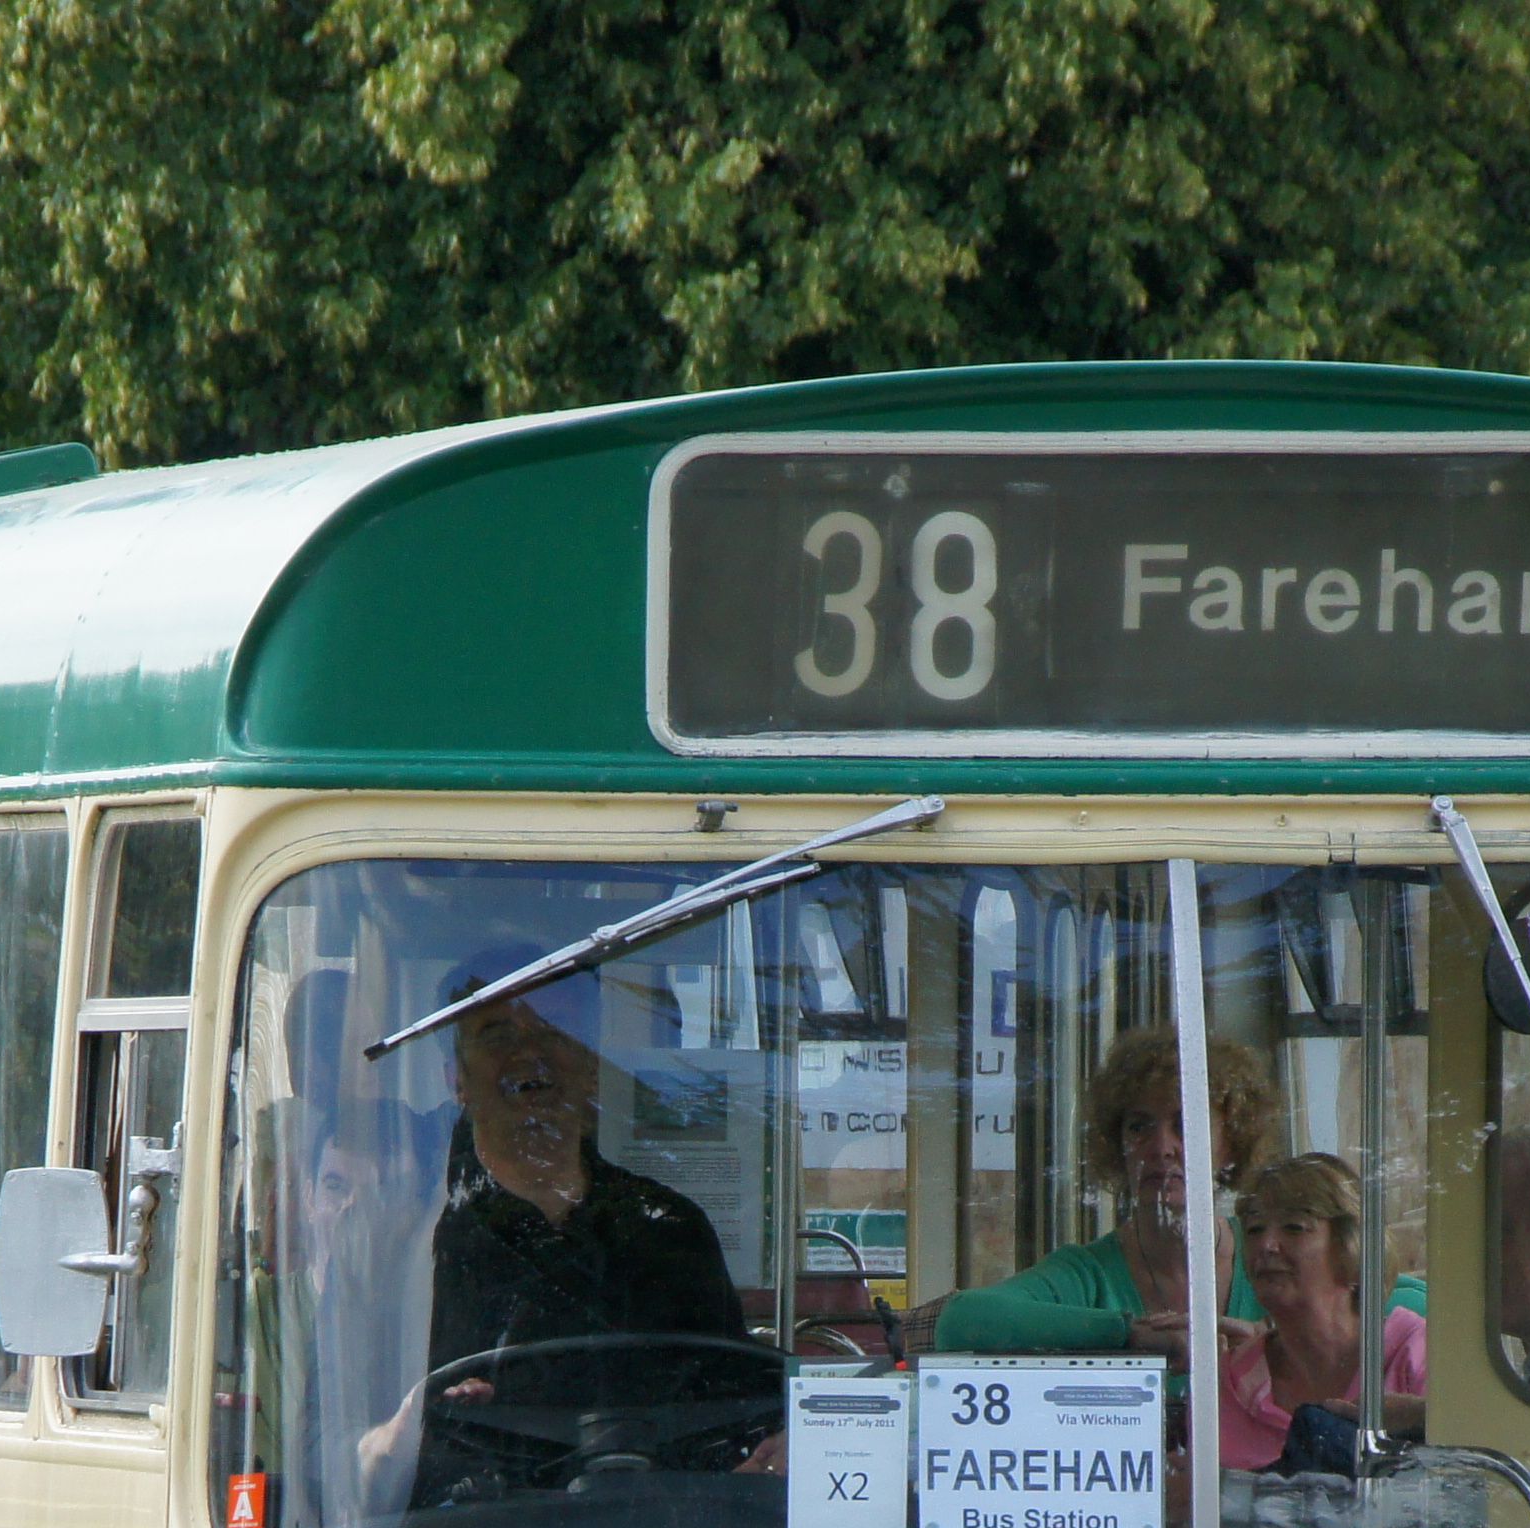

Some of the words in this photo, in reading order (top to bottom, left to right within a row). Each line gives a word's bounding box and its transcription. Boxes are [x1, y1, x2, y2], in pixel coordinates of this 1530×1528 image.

[793, 509, 999, 701] 38
[950, 1382, 1011, 1426] 38
[1057, 1413, 1078, 1426] Via
[1081, 1413, 1142, 1426] Wickham
[803, 1417, 835, 1428] Sunday
[856, 1417, 872, 1428] July
[874, 1418, 895, 1428] 2011
[926, 1448, 1154, 1493] FAREHAM
[828, 1471, 870, 1502] X2
[232, 1490, 254, 1521] A
